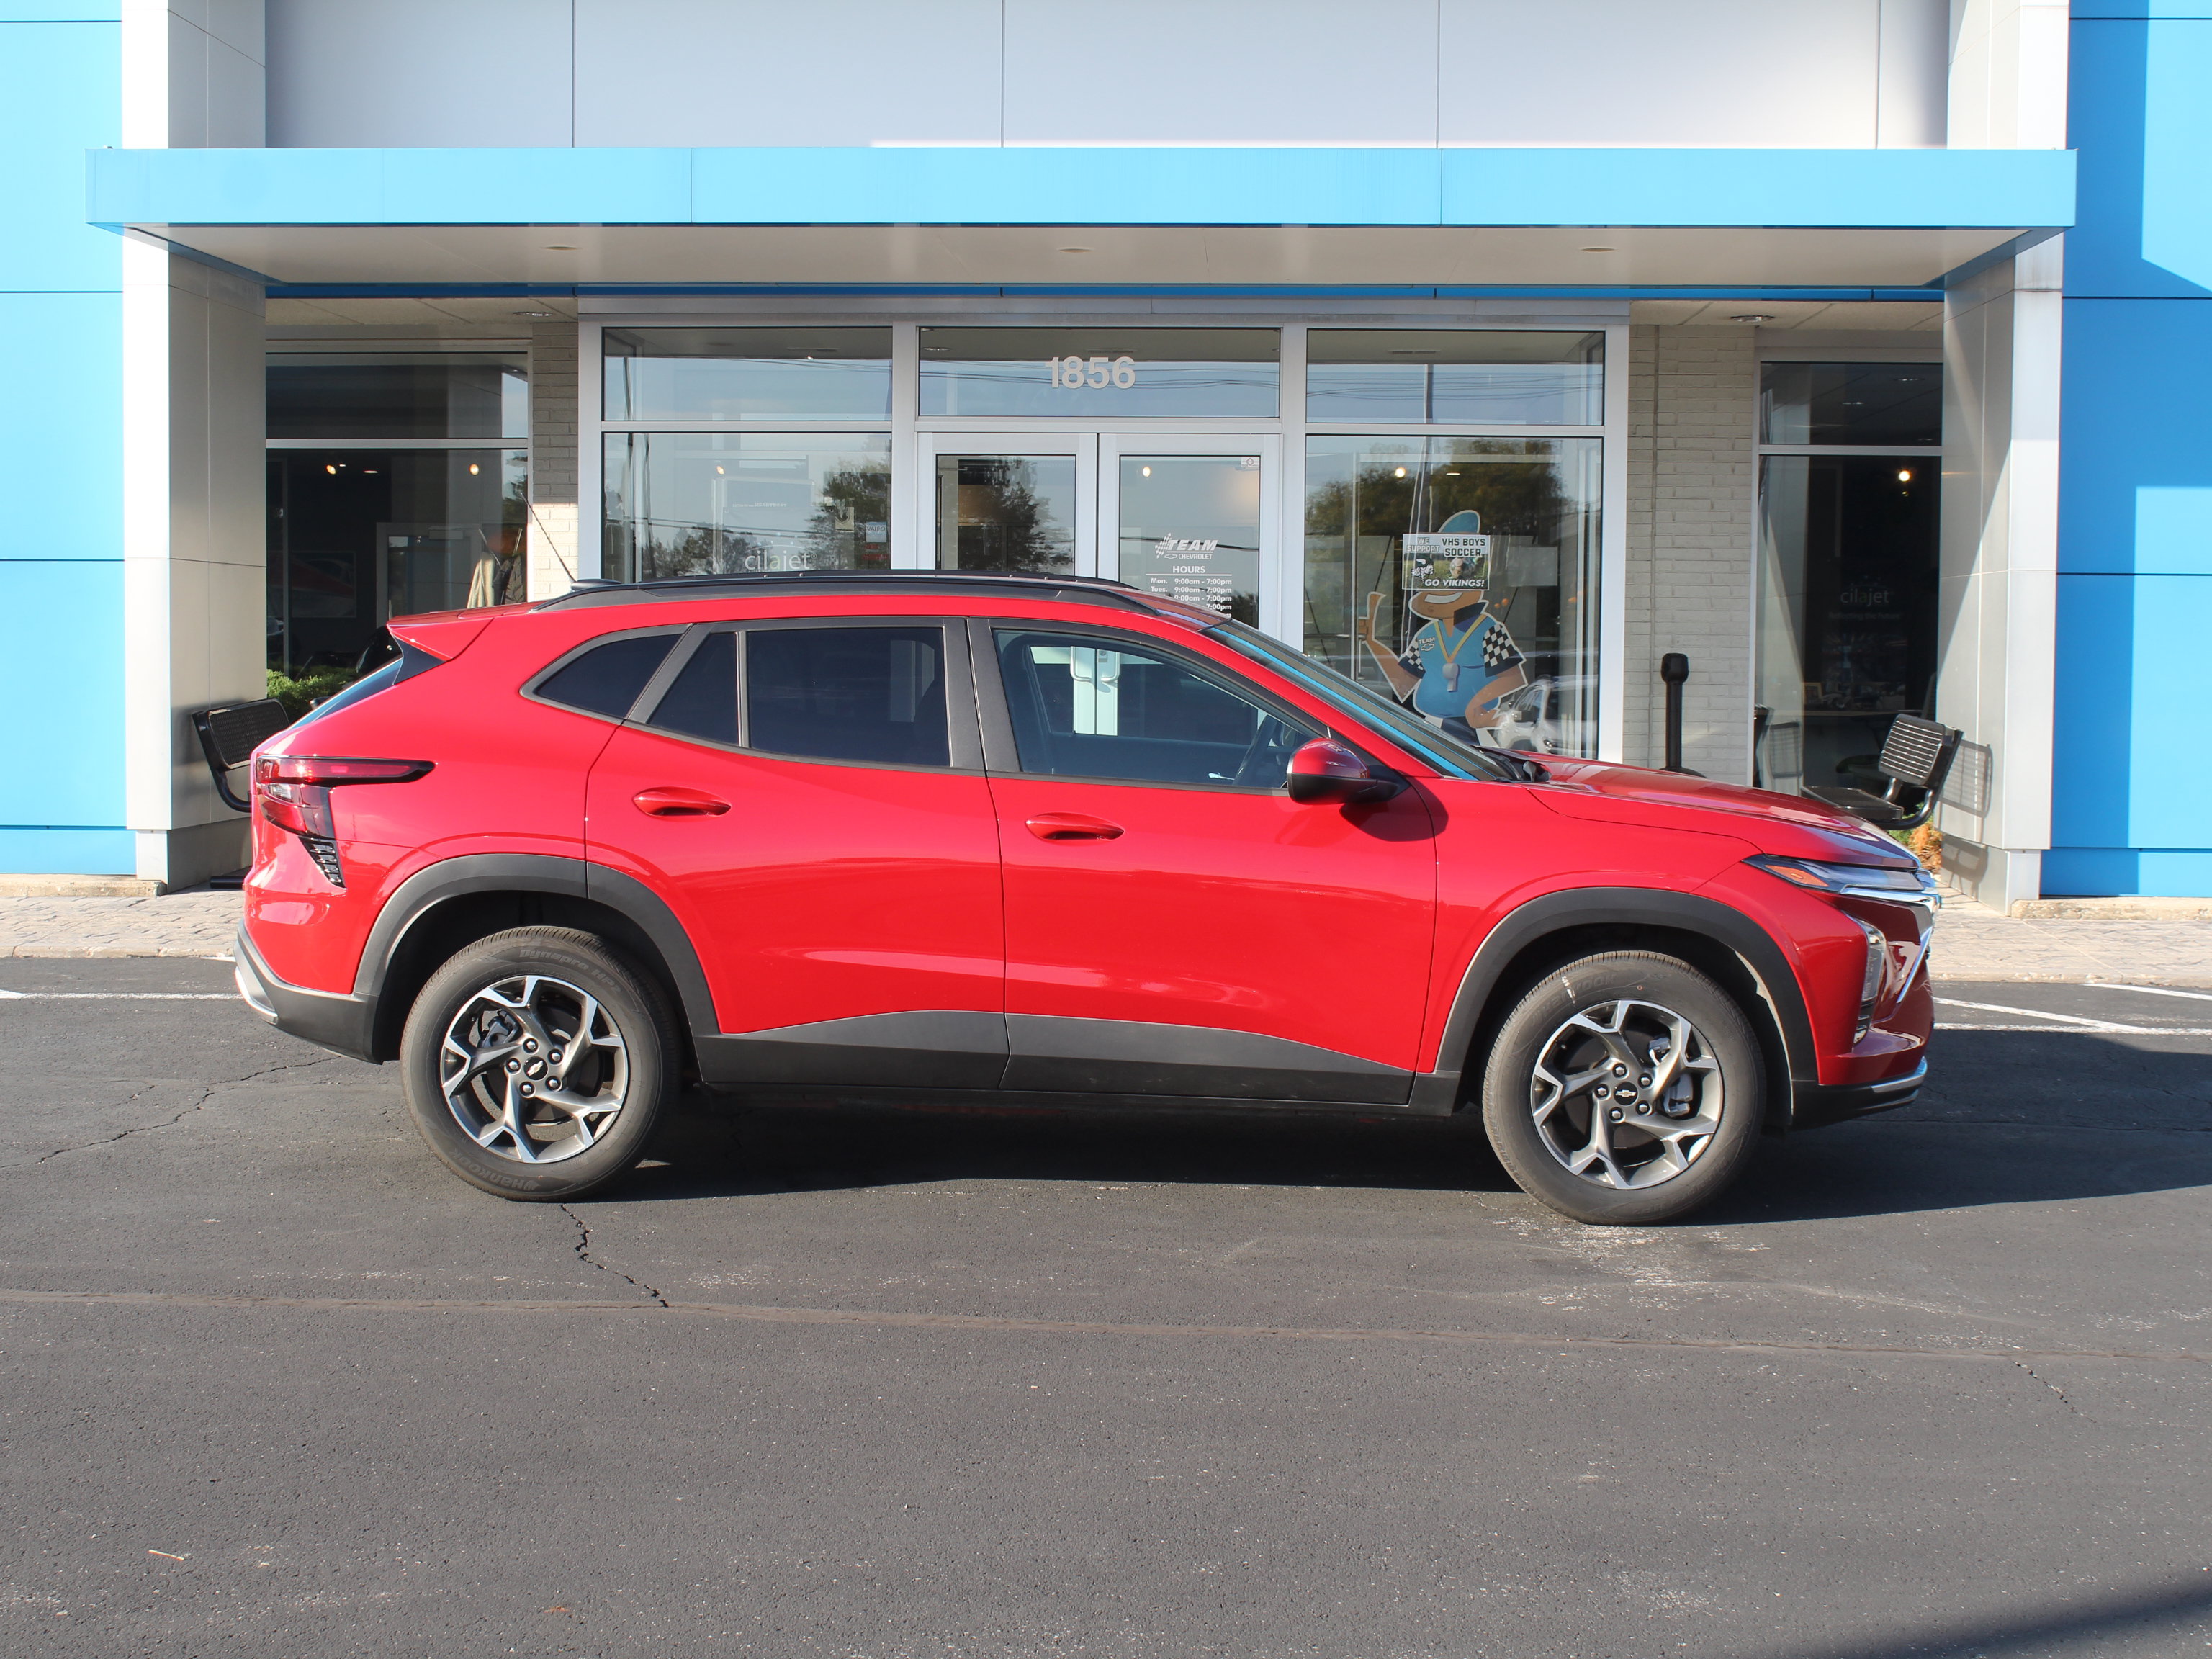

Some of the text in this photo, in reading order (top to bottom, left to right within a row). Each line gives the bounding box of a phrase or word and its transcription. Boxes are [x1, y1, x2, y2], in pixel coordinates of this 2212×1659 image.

[1045, 356, 1136, 389] 1856
[1167, 540, 1218, 550] TEAM
[1442, 538, 1485, 547] VHS BOYS
[1840, 589, 1889, 606] cilajet
[518, 948, 590, 971] Dynapro
